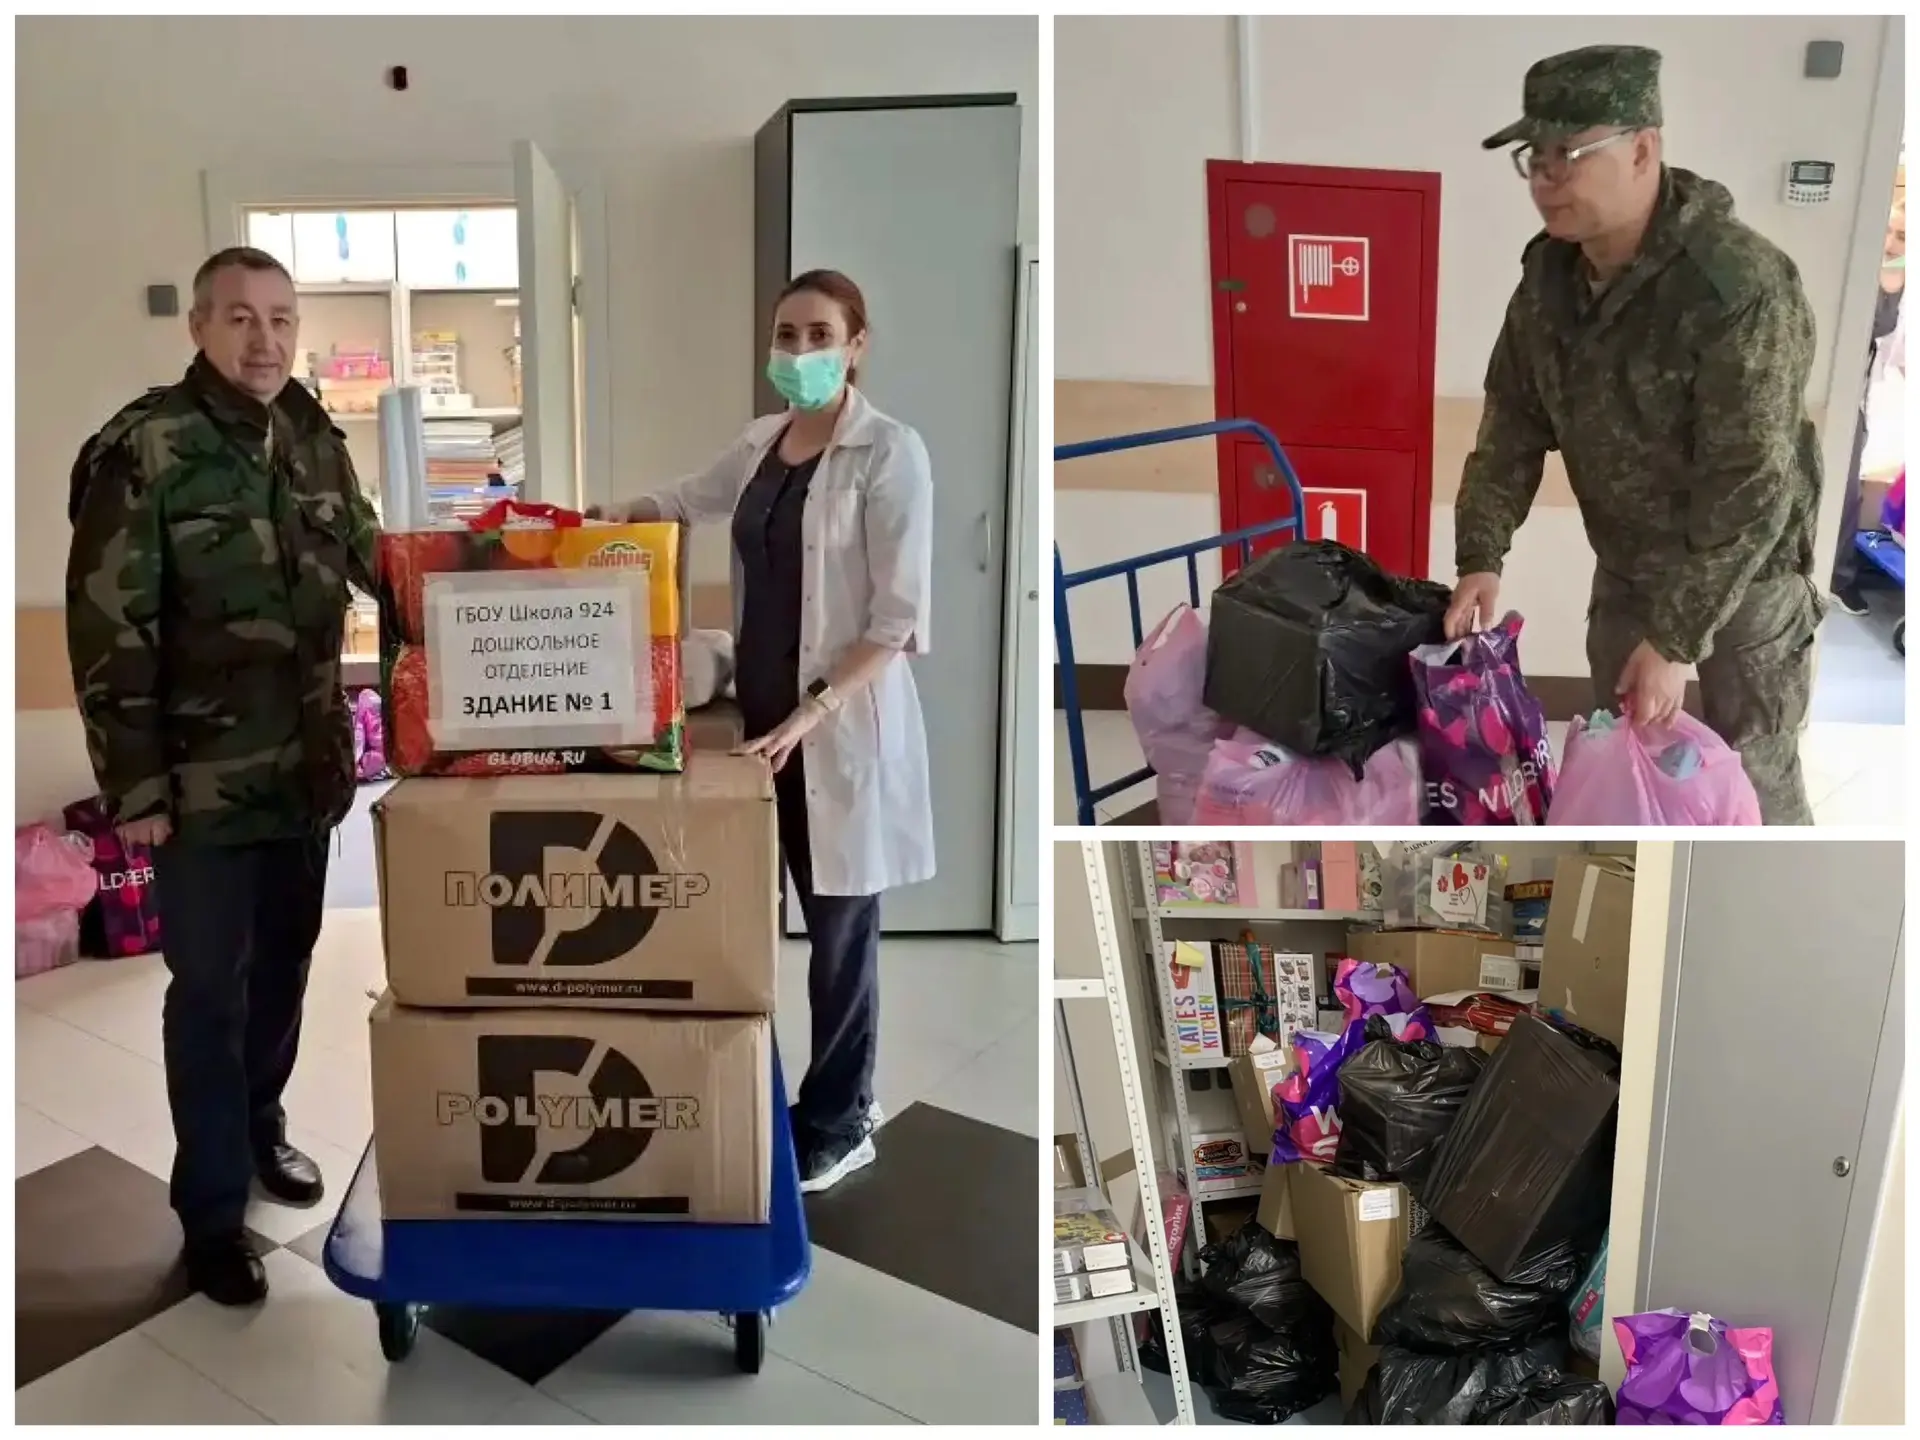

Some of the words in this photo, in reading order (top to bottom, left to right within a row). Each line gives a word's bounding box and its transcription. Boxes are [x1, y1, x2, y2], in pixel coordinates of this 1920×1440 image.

[456, 605, 503, 624] ГБОУ
[510, 603, 573, 622] Школа
[579, 601, 615, 618] 924
[471, 633, 600, 656] ДОШКОЛЬНОЕ
[484, 661, 589, 681] ОТДЕЛЕНИЕ
[462, 694, 558, 718] ЗДАНИЕ
[565, 692, 593, 711] №
[601, 692, 613, 710] 1
[487, 750, 586, 766] GLOBUS.RU
[444, 871, 710, 909] ПОЛИМЕР
[1197, 994, 1219, 1049] KITCHEN
[436, 1091, 701, 1130] POLYMER
